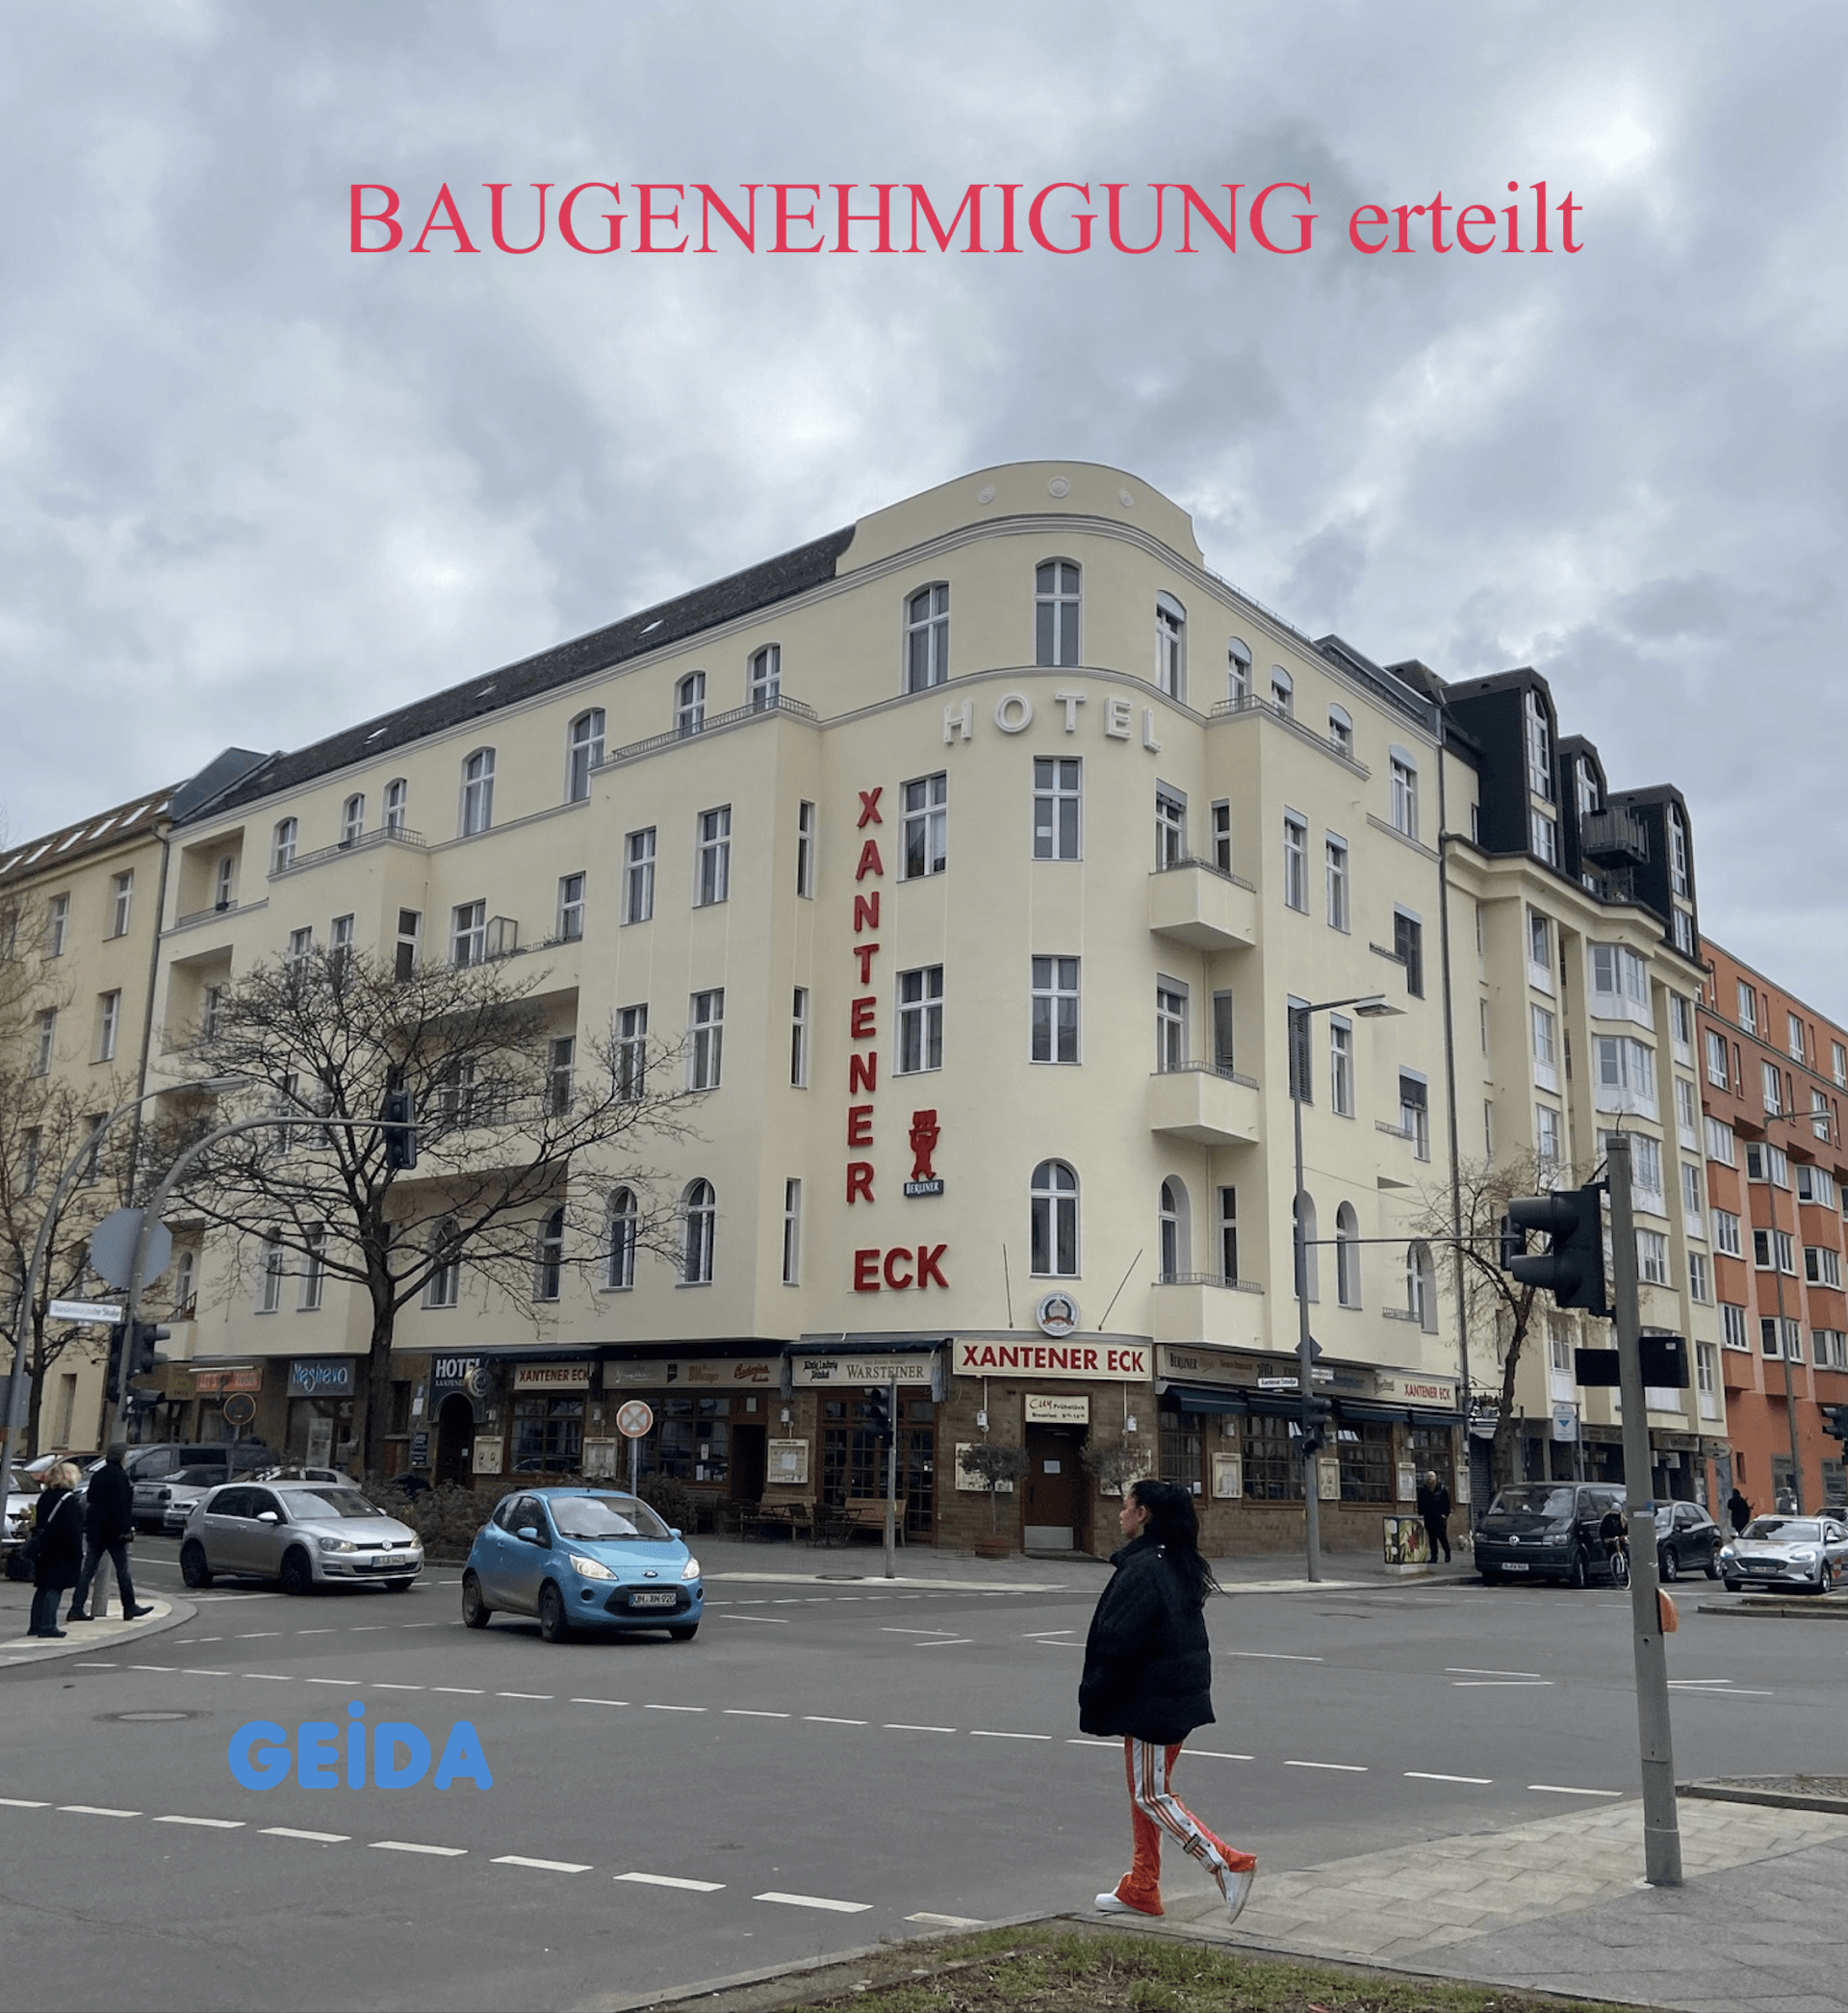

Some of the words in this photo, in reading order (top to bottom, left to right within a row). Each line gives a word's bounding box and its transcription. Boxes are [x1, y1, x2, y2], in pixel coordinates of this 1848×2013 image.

[942, 692, 1161, 754] HOTEL
[847, 787, 882, 1202] XANTENER
[906, 1181, 939, 1195] BERLINER
[853, 1245, 949, 1292] ECK
[962, 1347, 1096, 1369] XANTENER
[1109, 1352, 1142, 1371] ECK
[519, 1369, 569, 1381] XANTENER
[847, 1364, 924, 1379] WARSTEINER
[1404, 1383, 1438, 1399] XANTENER
[1439, 1387, 1451, 1401] ECK
